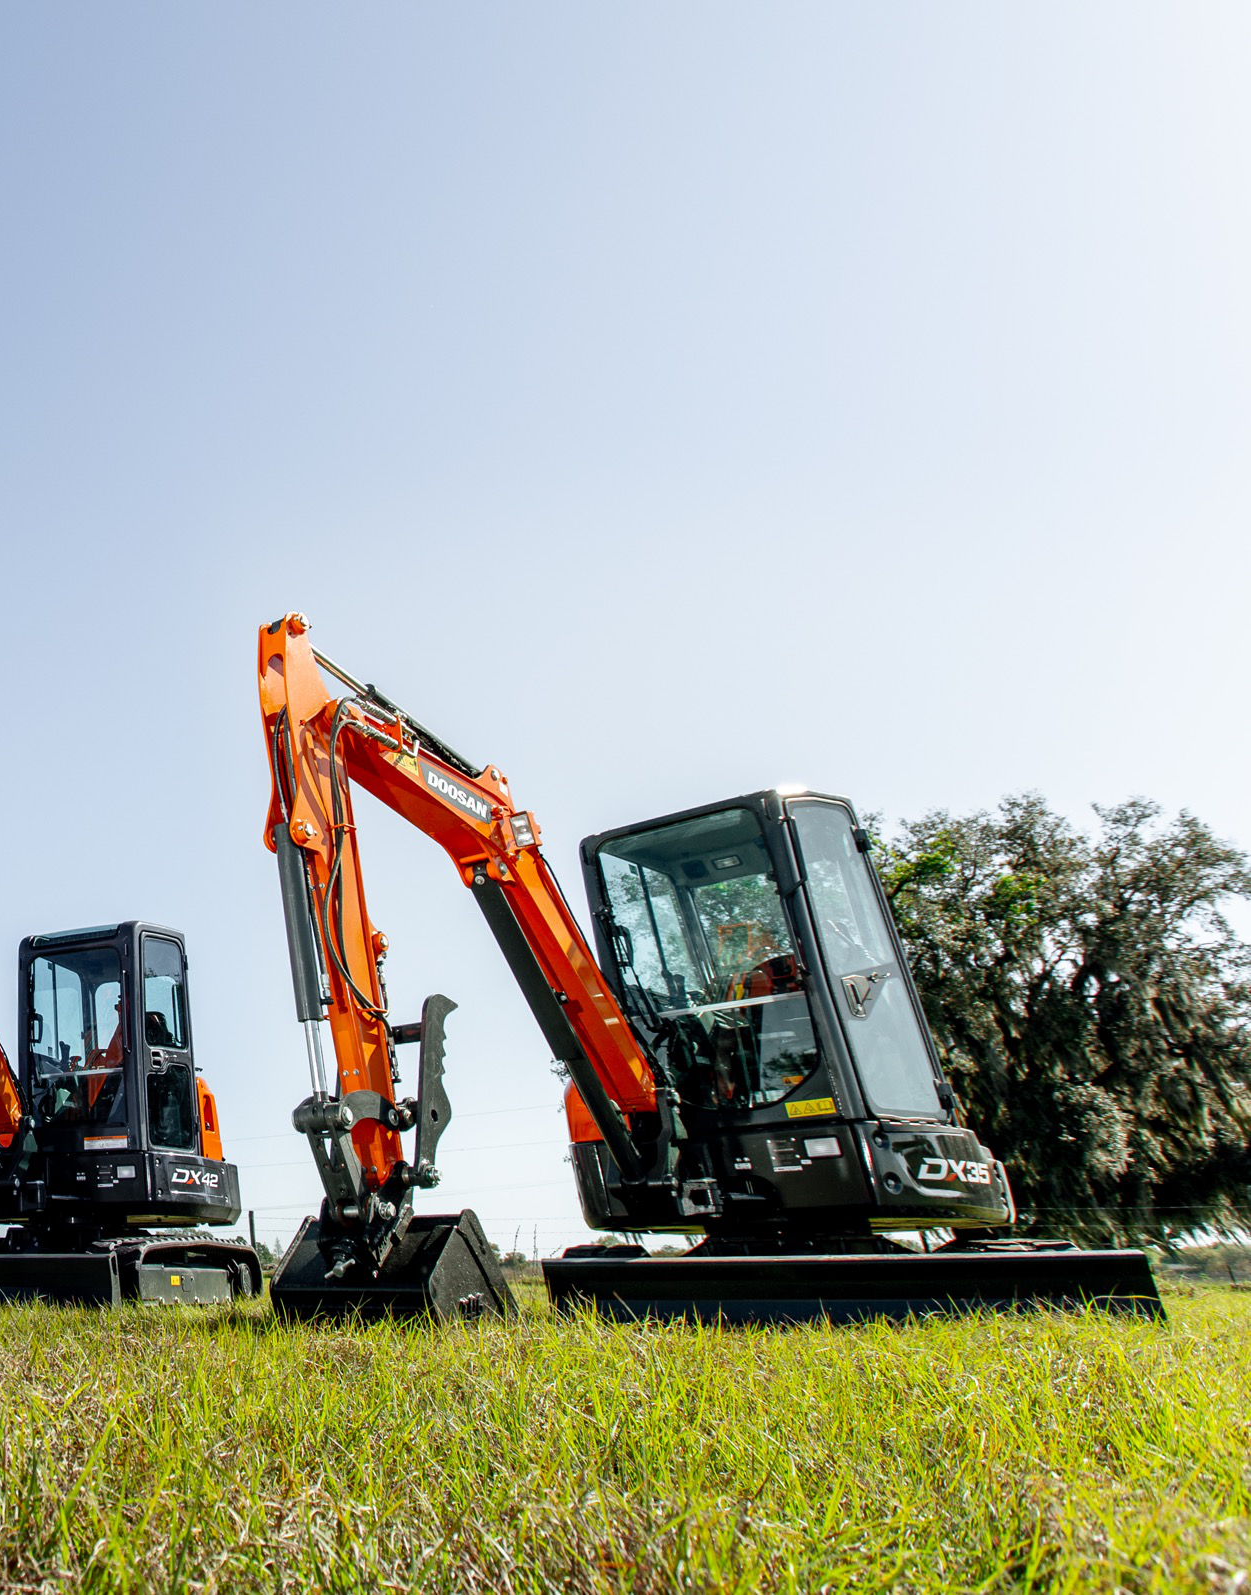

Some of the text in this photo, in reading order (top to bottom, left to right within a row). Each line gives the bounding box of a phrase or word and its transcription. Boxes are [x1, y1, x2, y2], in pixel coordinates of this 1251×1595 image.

[428, 771, 487, 818] DOOSAN
[171, 1168, 218, 1187] DX42
[917, 1157, 991, 1184] DX35
